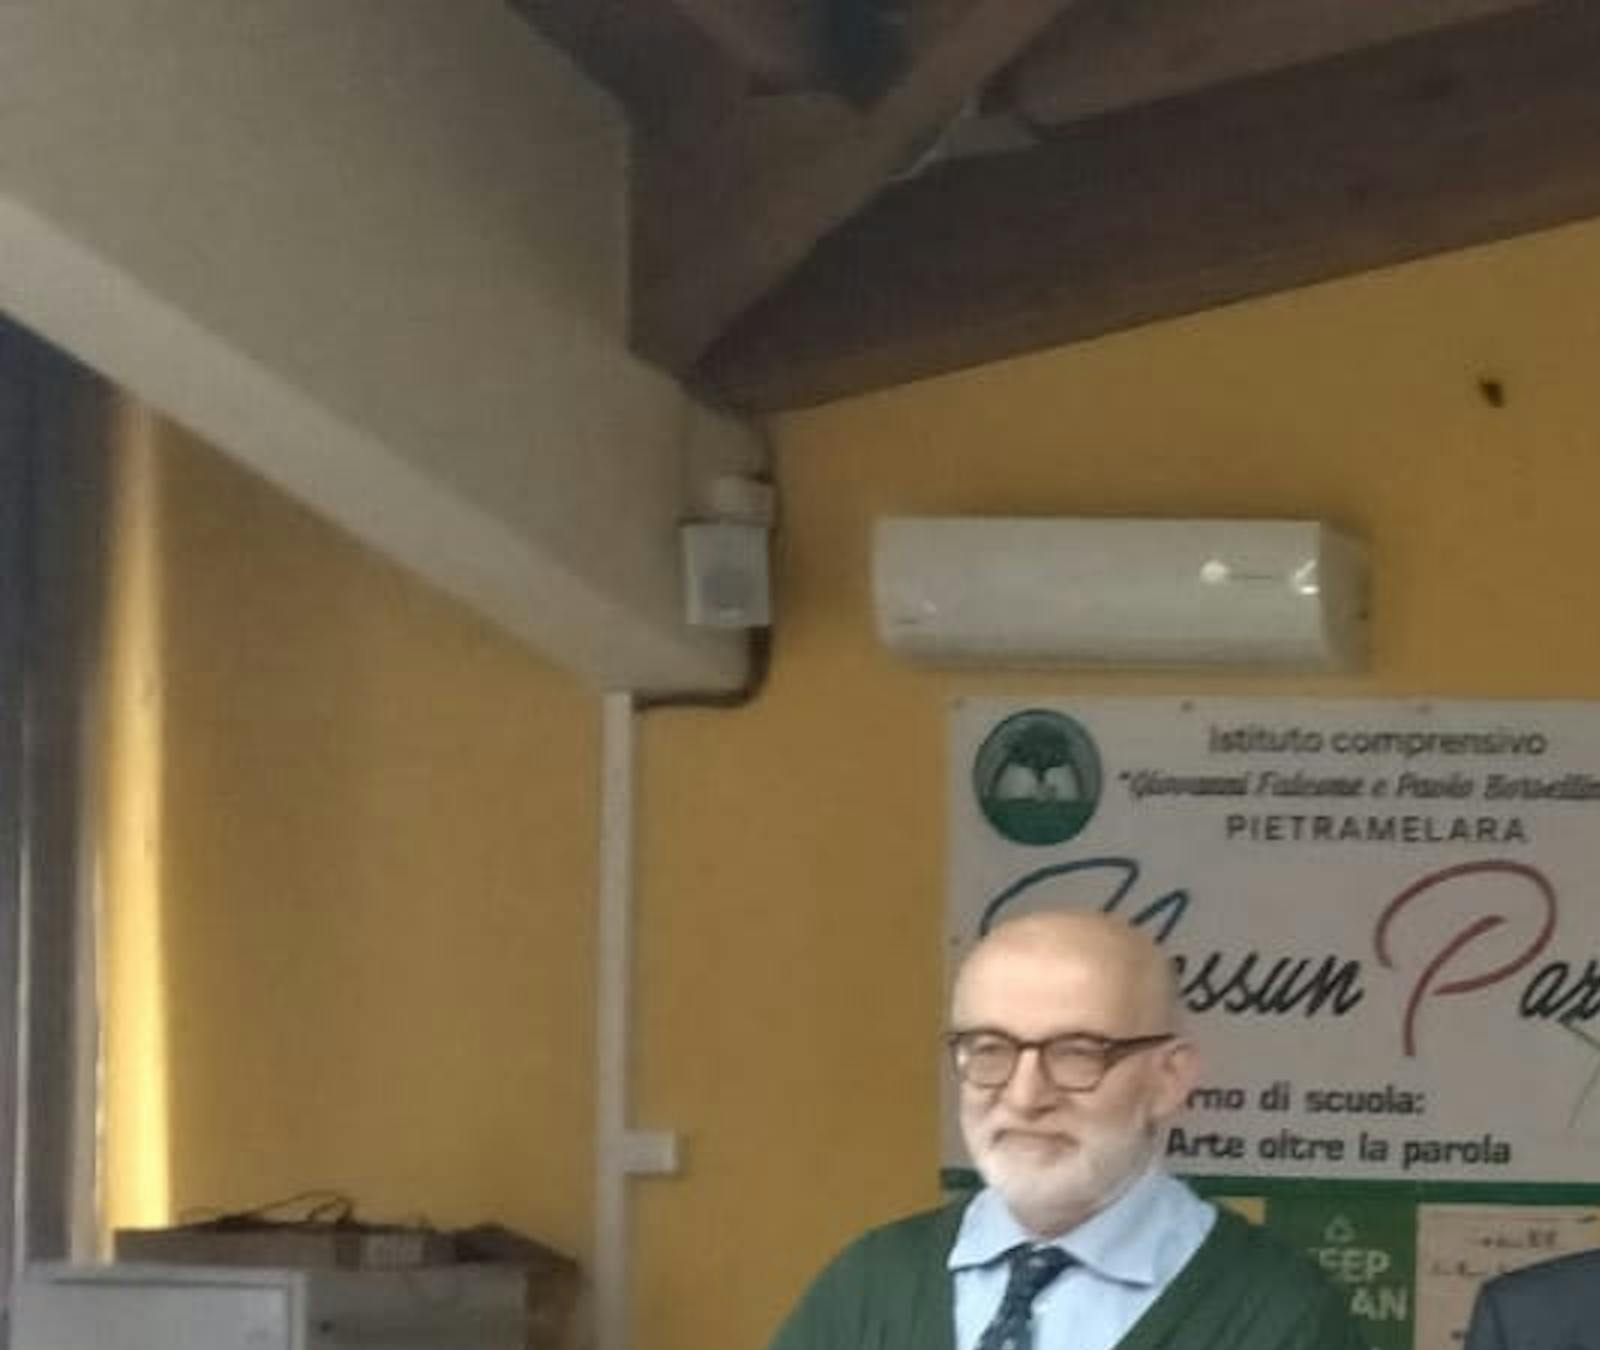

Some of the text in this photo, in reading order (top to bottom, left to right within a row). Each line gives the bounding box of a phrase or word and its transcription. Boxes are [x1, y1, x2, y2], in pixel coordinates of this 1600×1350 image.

[1207, 726, 1550, 761] Istituto comprensivo
[1226, 815, 1530, 844] PIETRAMELARA
[1259, 1081, 1292, 1112] di
[1305, 1085, 1427, 1116] scuola:
[1165, 1127, 1514, 1170] Arte oltre la parola
